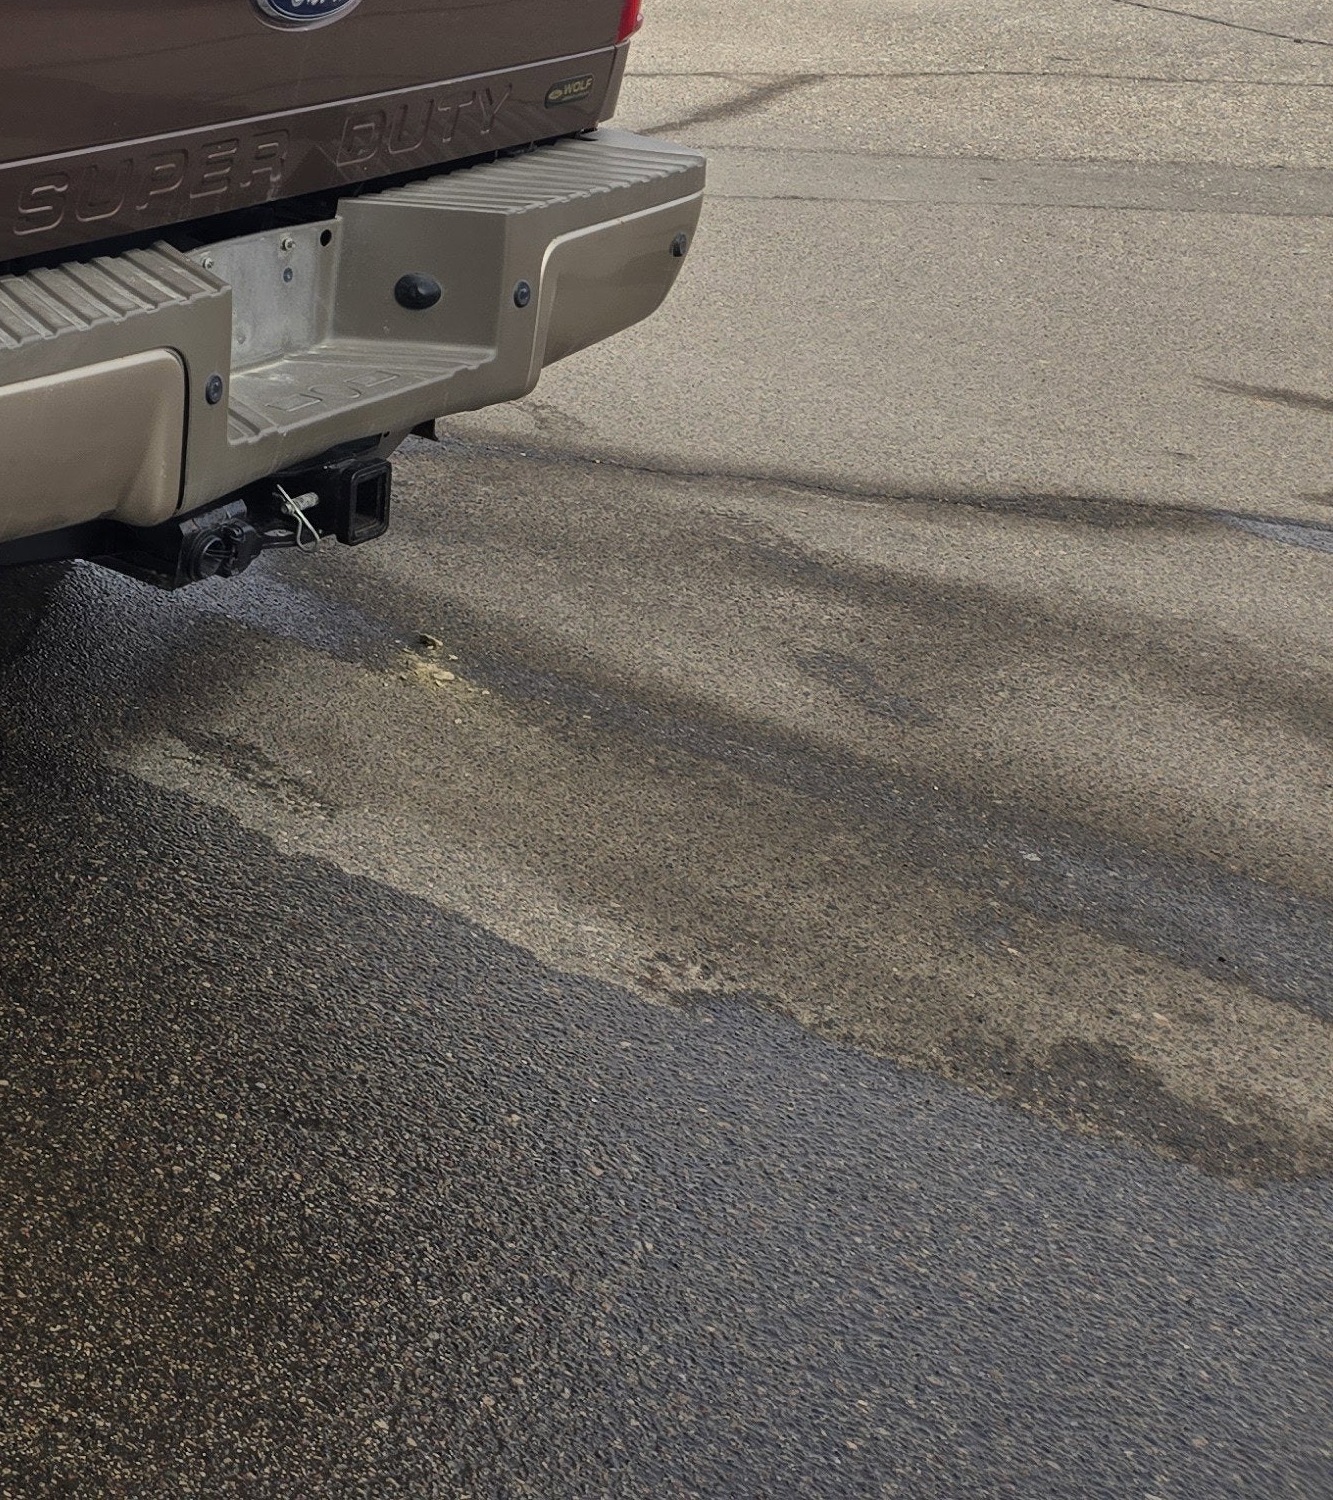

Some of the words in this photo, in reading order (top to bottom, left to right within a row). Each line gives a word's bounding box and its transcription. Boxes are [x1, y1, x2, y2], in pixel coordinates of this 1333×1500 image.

[564, 78, 593, 95] WOLF
[12, 128, 291, 238] SUPER
[334, 82, 513, 167] DUTY
